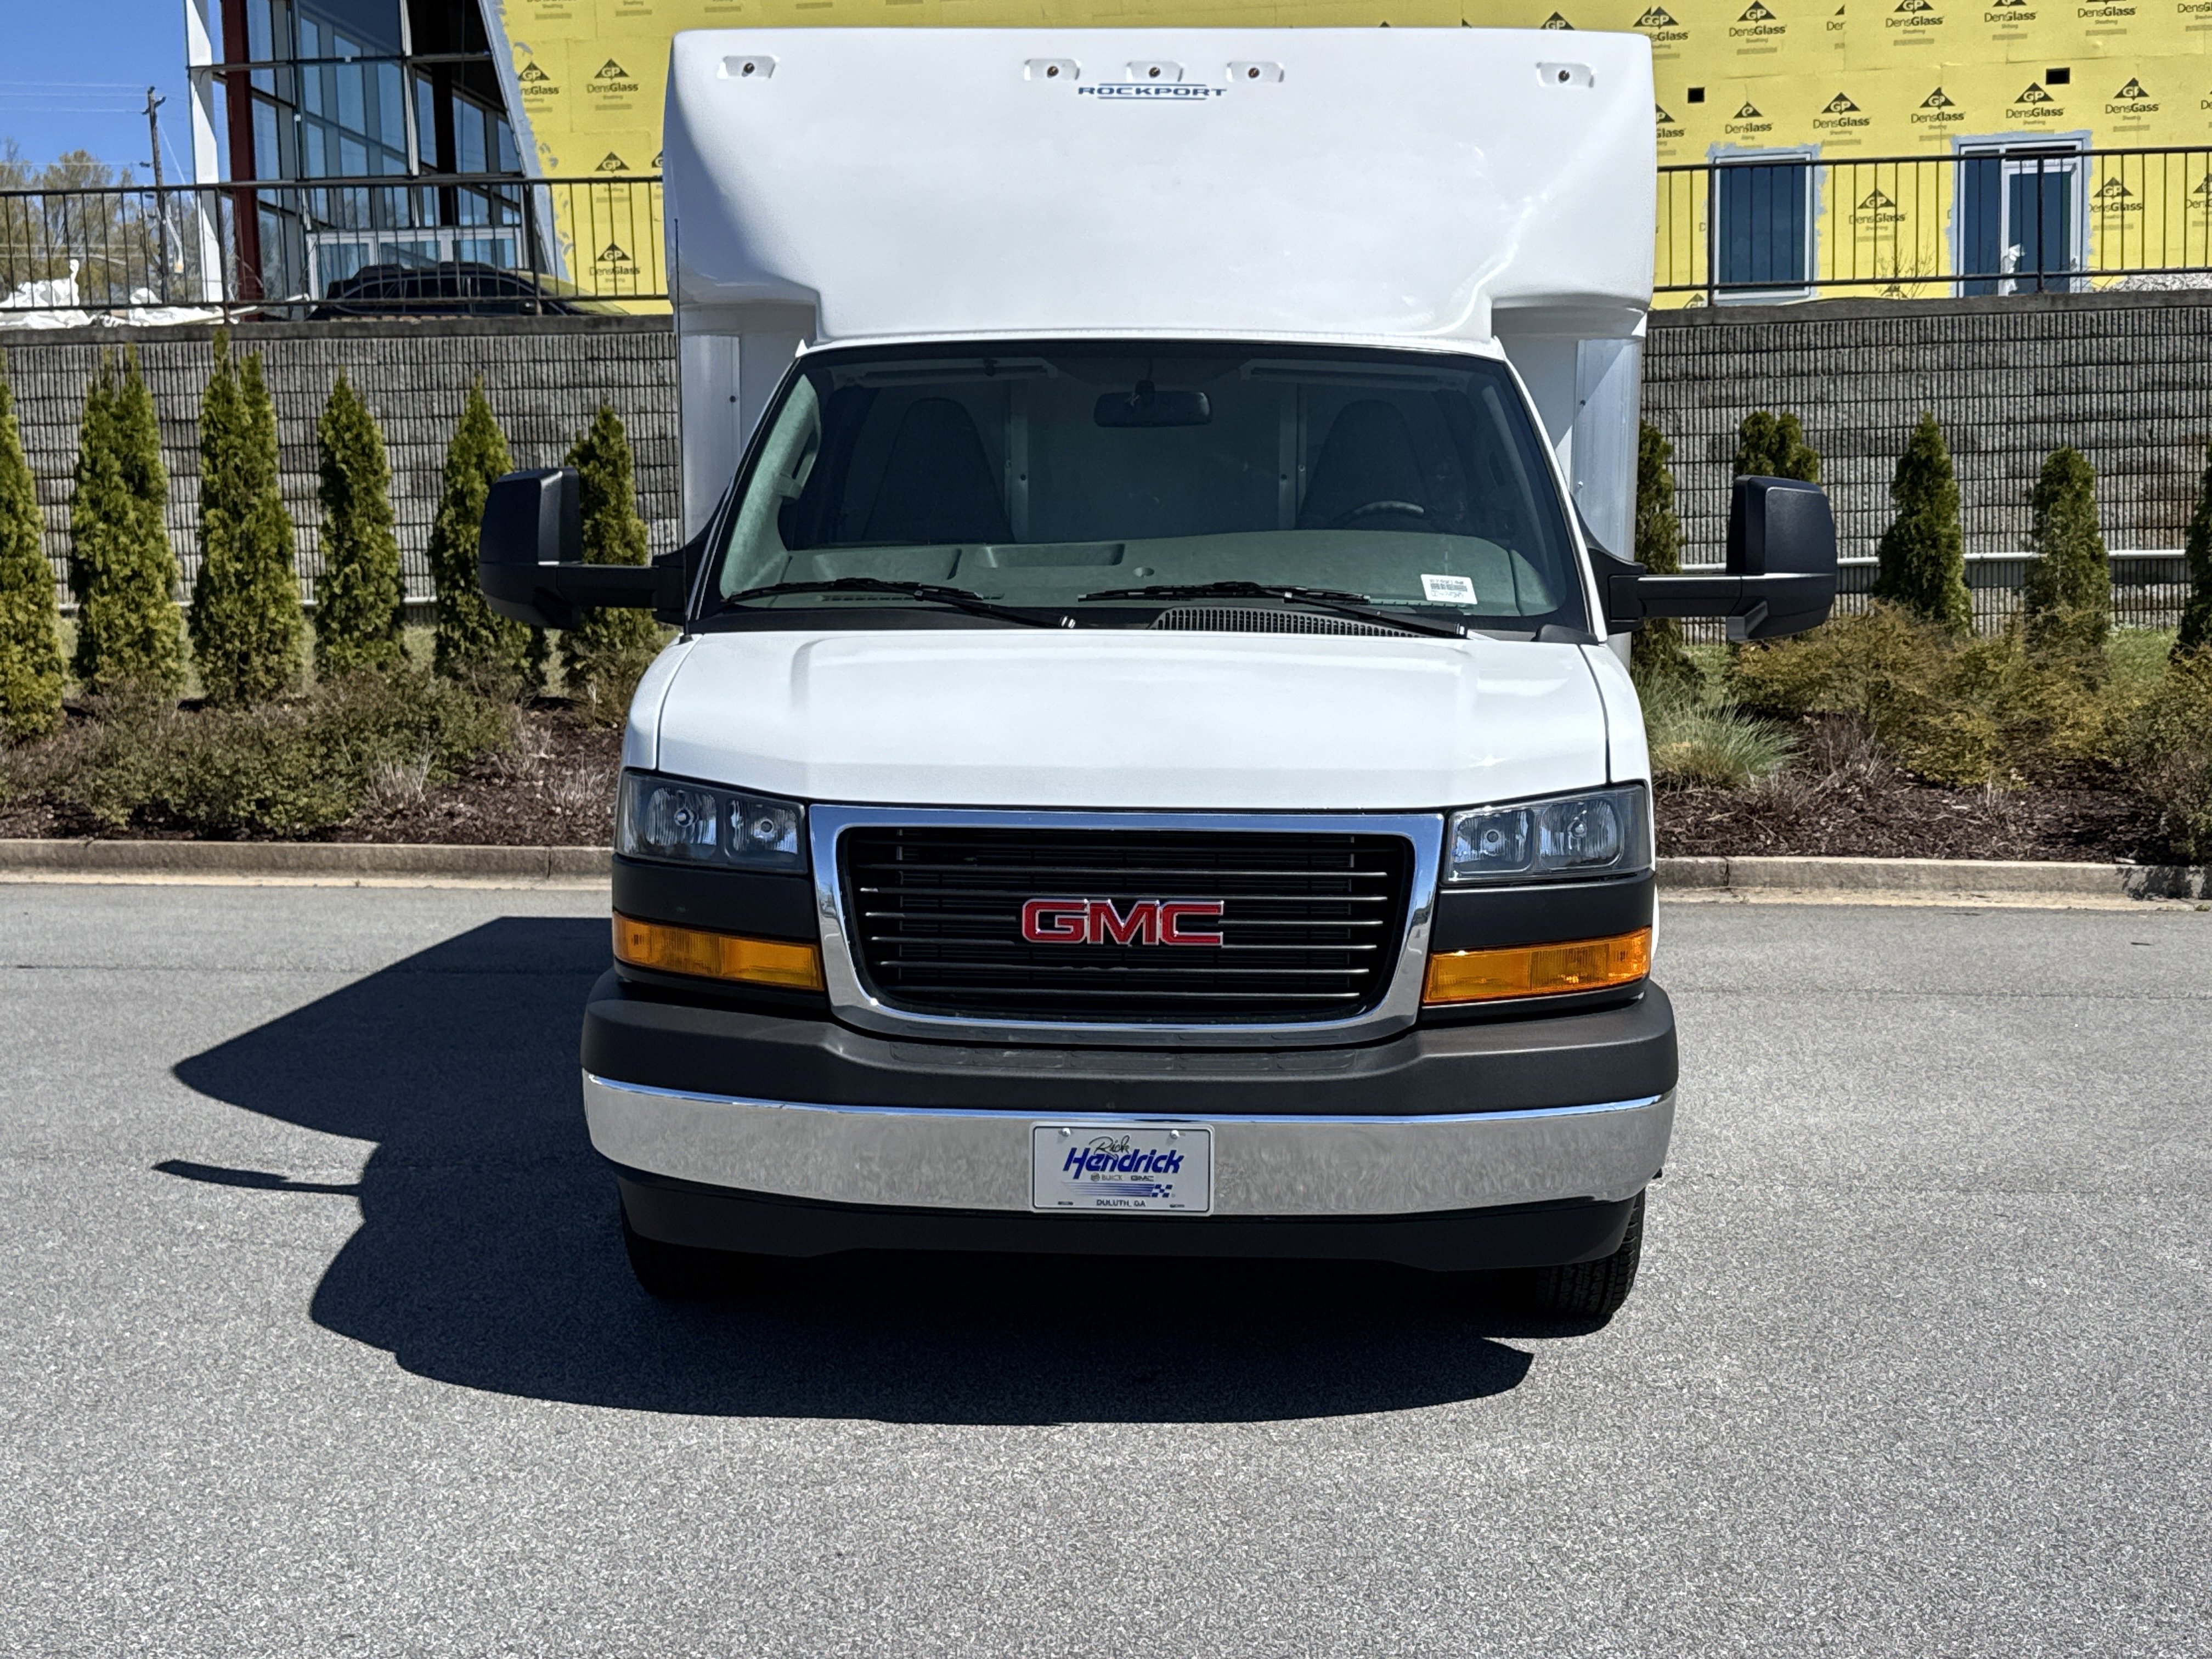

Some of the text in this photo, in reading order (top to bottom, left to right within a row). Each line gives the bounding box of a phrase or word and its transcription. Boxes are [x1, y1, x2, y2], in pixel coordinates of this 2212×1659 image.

[2078, 7, 2136, 18] DensGlass
[2177, 2, 2212, 13] DensGl
[1746, 9, 1767, 20] GP
[1886, 16, 1944, 27] DensGlass
[1729, 25, 1785, 37] DensGlass
[522, 70, 541, 80] GP
[601, 67, 620, 77] GP
[520, 85, 559, 95] nsGlass
[587, 82, 639, 93] DensGlass
[1078, 87, 1227, 97] ROCKPORT
[2023, 91, 2045, 102] GP
[1830, 101, 1852, 112] GP
[2006, 108, 2064, 119] DensGlass
[1813, 117, 1870, 129] DensGlass
[602, 160, 622, 170] GP
[1022, 899, 1224, 946] GMC
[1089, 1135, 1130, 1156] Rick
[1063, 1147, 1184, 1180] Hendrick
